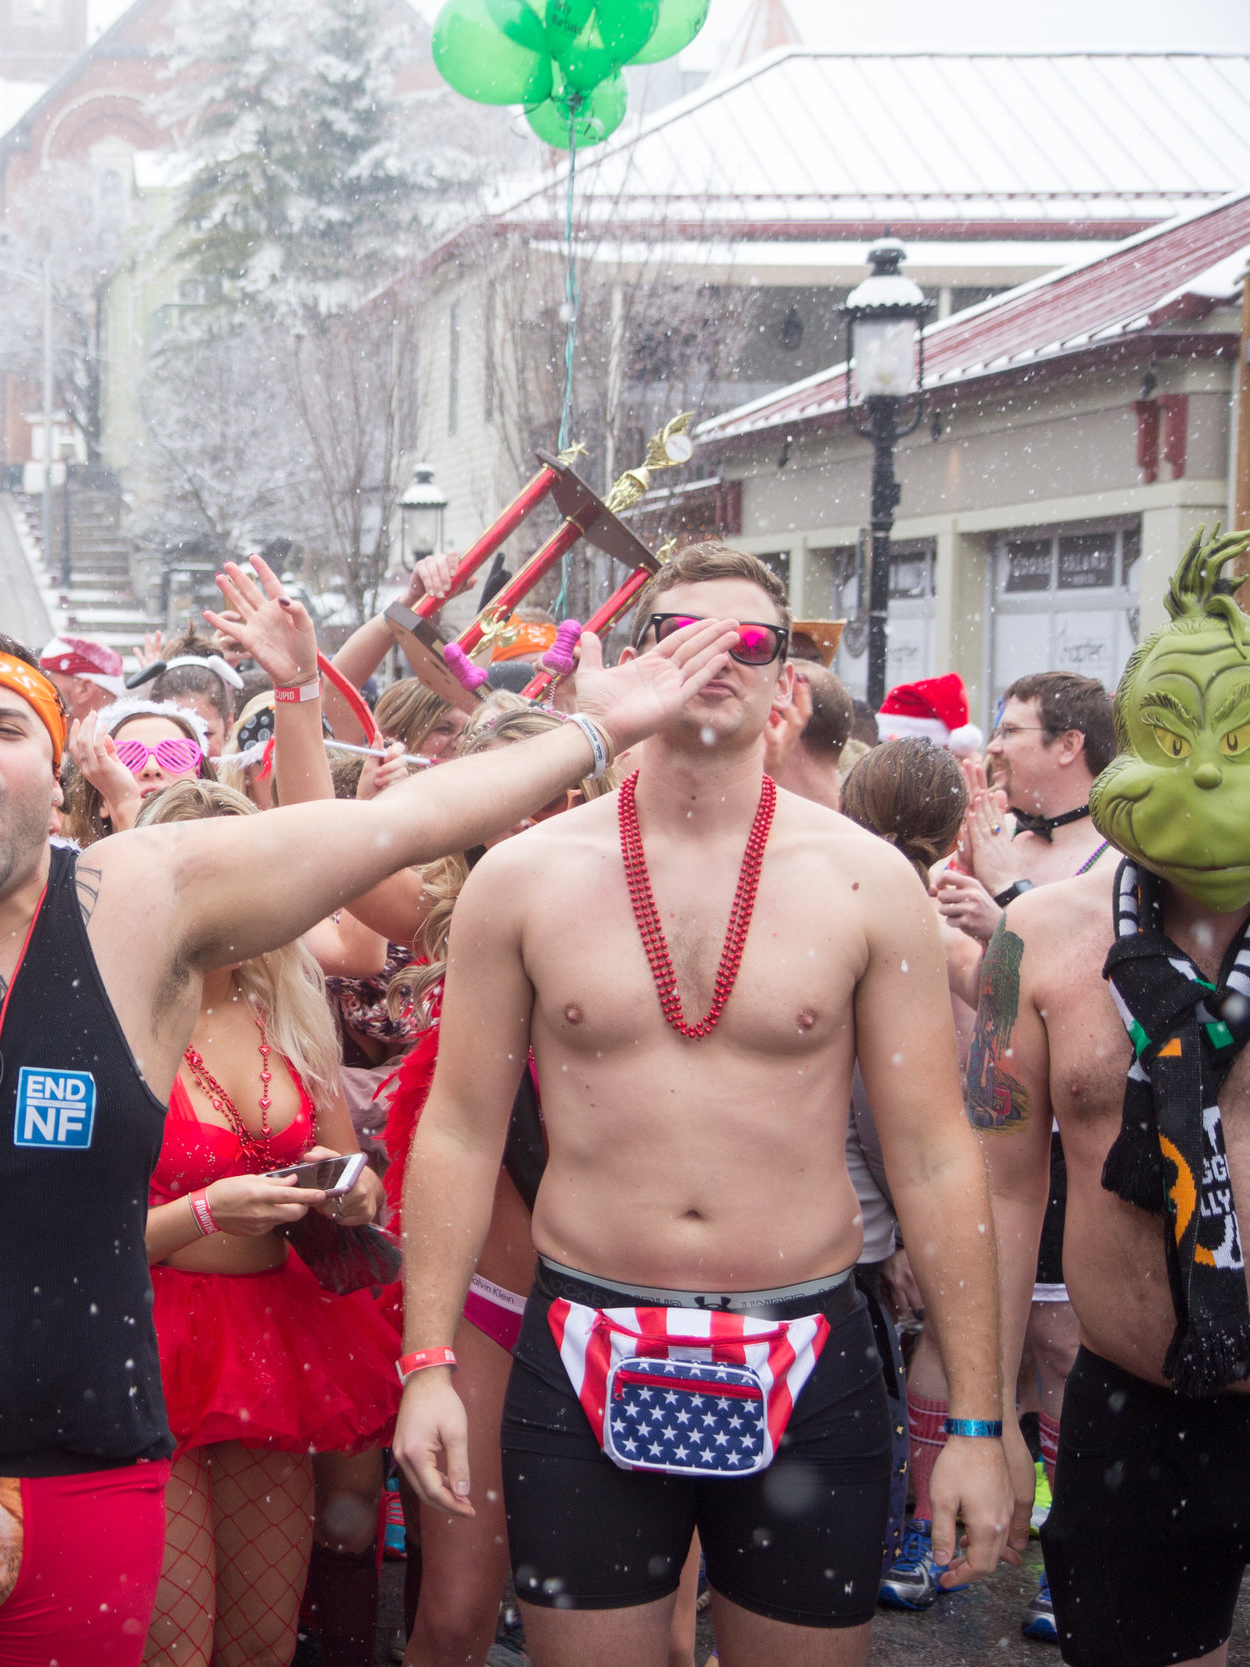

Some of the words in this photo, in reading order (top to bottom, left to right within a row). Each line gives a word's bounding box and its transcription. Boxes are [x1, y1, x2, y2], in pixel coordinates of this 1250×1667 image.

[27, 1075, 86, 1101] END
[24, 1105, 86, 1142] NF
[471, 1278, 491, 1293] alvin
[492, 1287, 514, 1304] Klein
